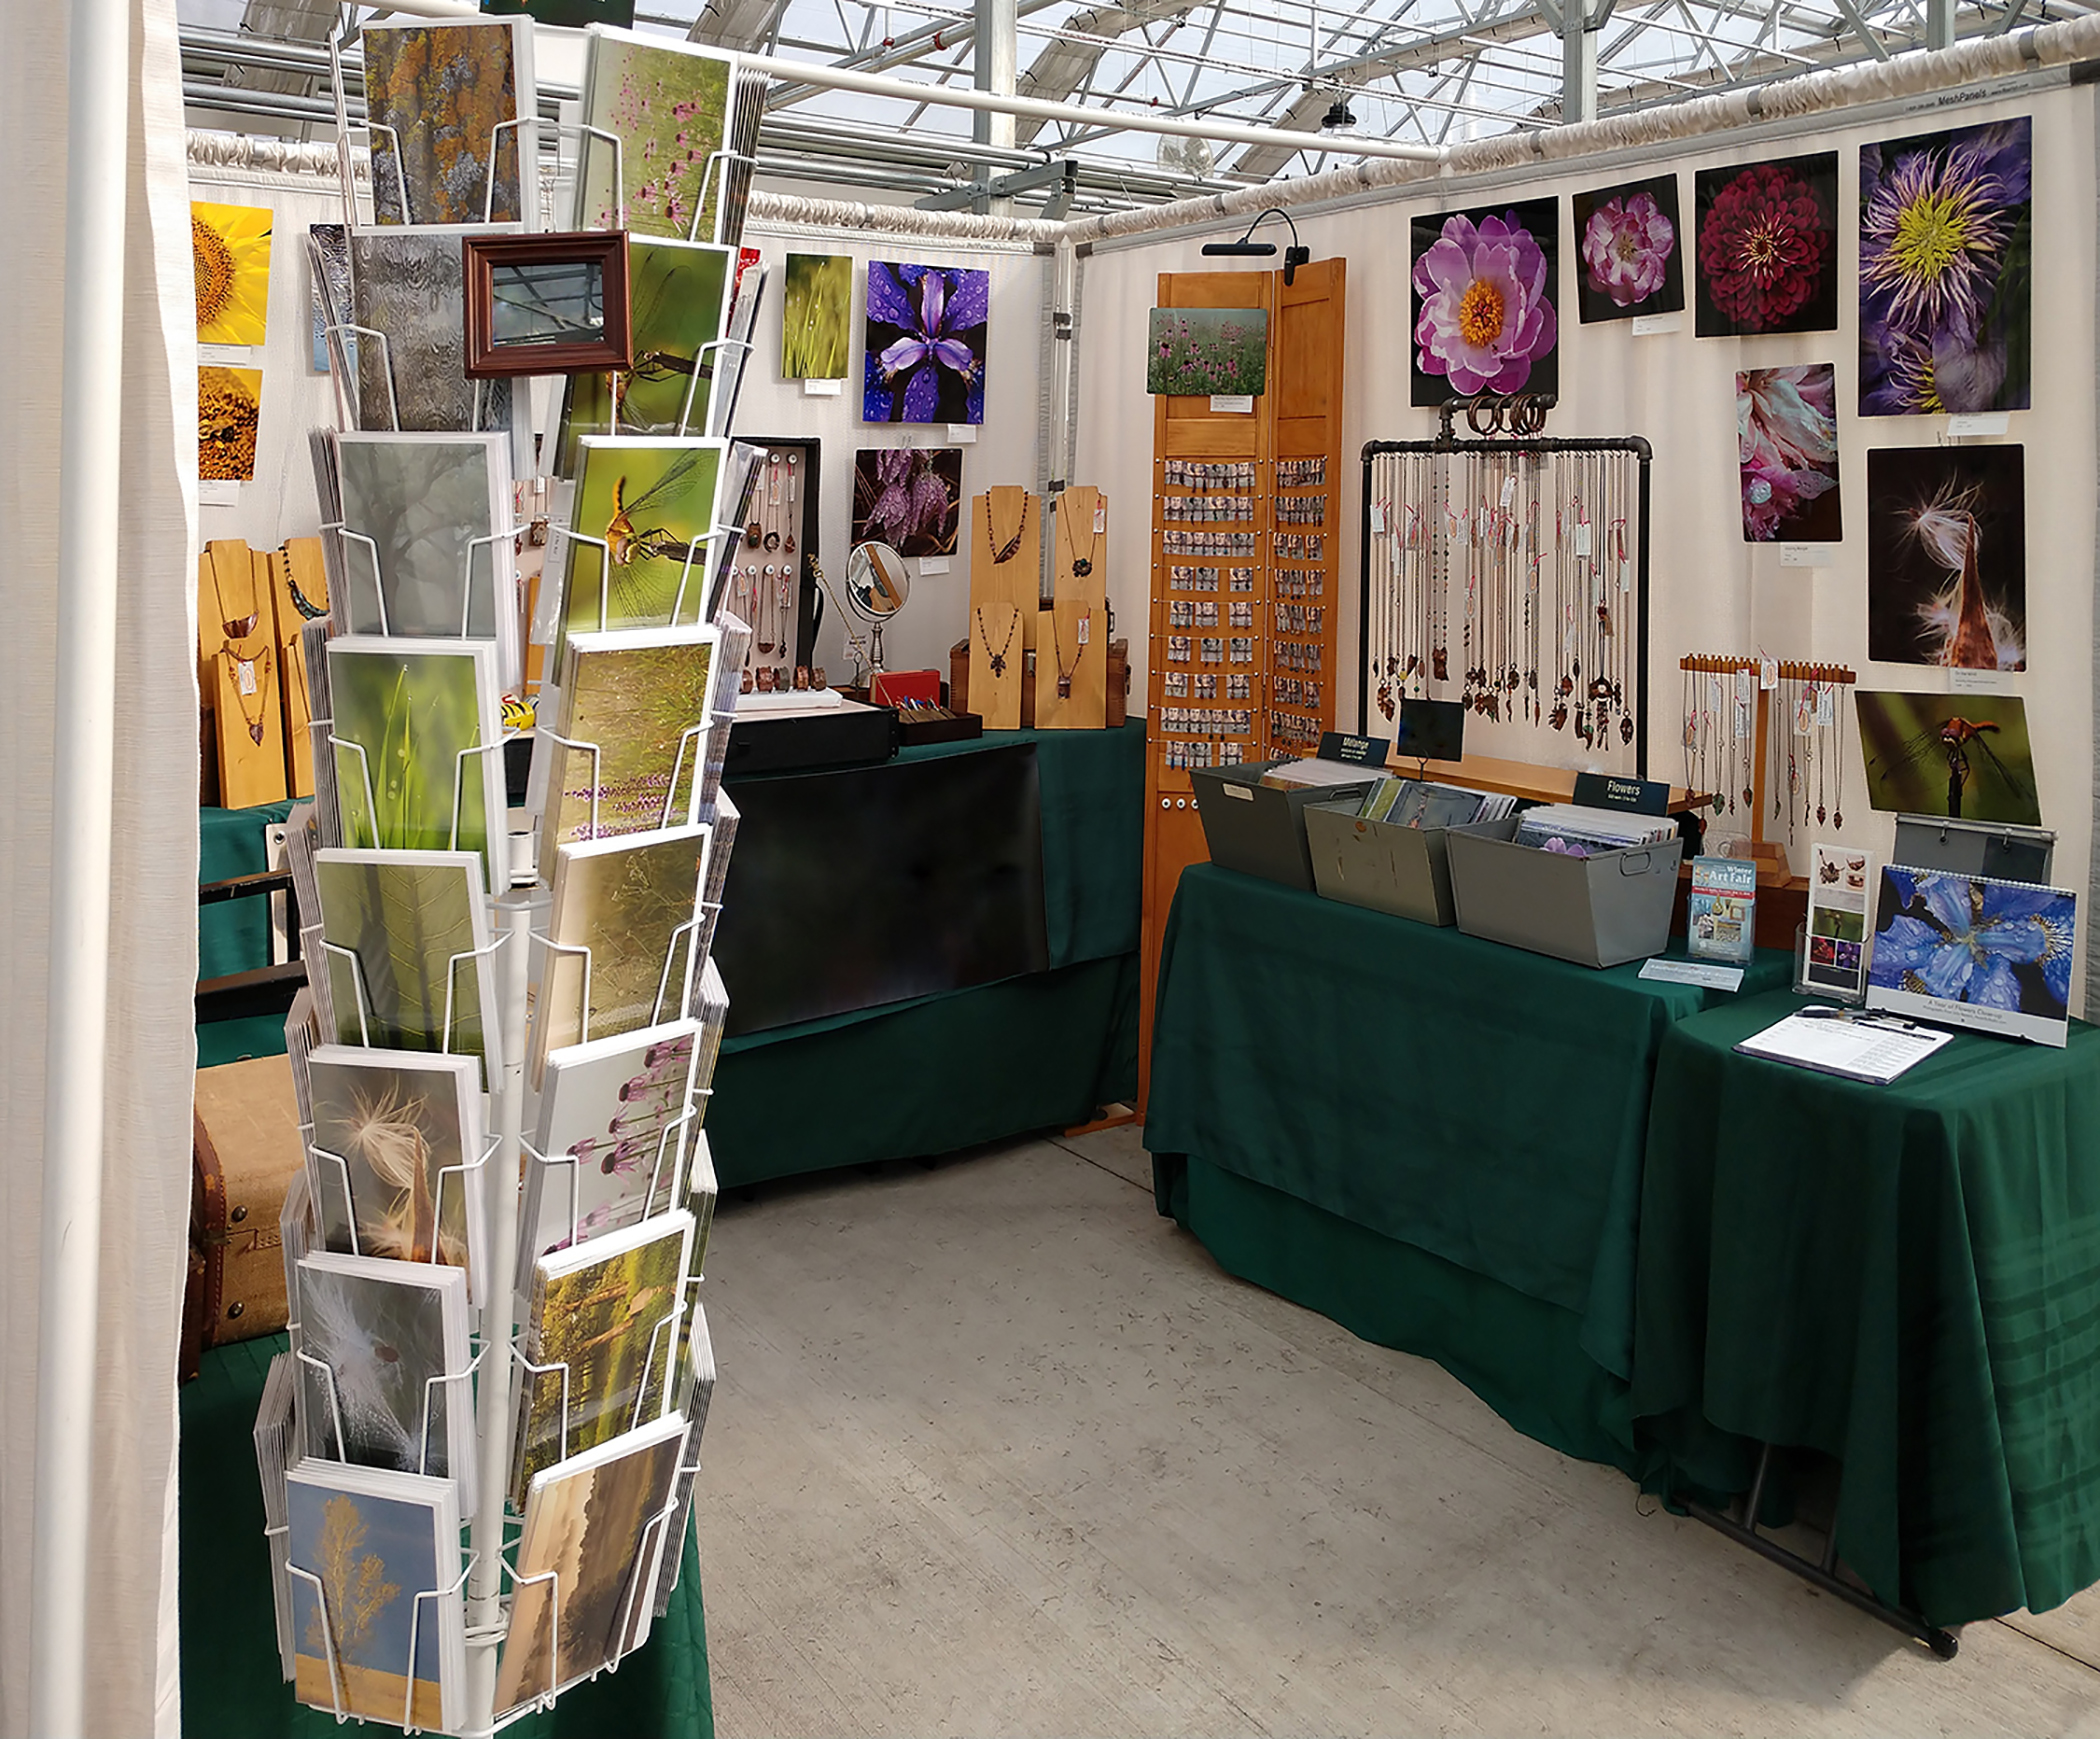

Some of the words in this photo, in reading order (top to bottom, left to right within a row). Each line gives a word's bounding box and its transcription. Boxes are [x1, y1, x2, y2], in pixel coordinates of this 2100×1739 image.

[1937, 88, 1987, 107] MeshPanels
[1607, 779, 1642, 797] Flowers
[1709, 870, 1728, 883] Art
[1730, 873, 1753, 885] Fair
[1726, 865, 1753, 876] Winter
